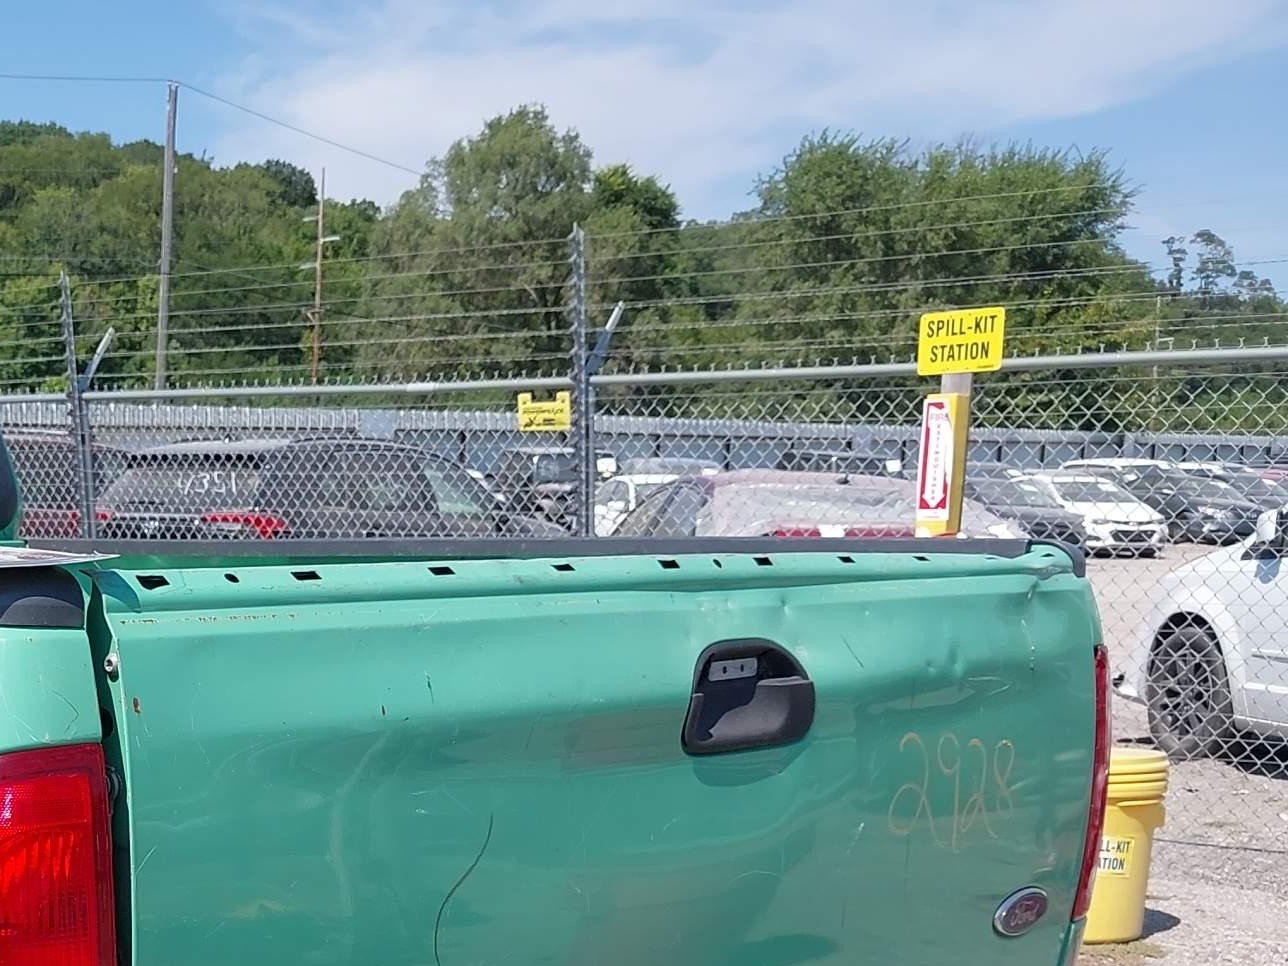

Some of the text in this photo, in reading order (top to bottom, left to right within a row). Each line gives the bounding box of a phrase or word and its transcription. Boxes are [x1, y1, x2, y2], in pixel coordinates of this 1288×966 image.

[927, 315, 998, 338] SPILL-KIT
[930, 341, 990, 363] STATION
[888, 731, 1016, 853] 2928
[1097, 840, 1131, 853] LL-KIT
